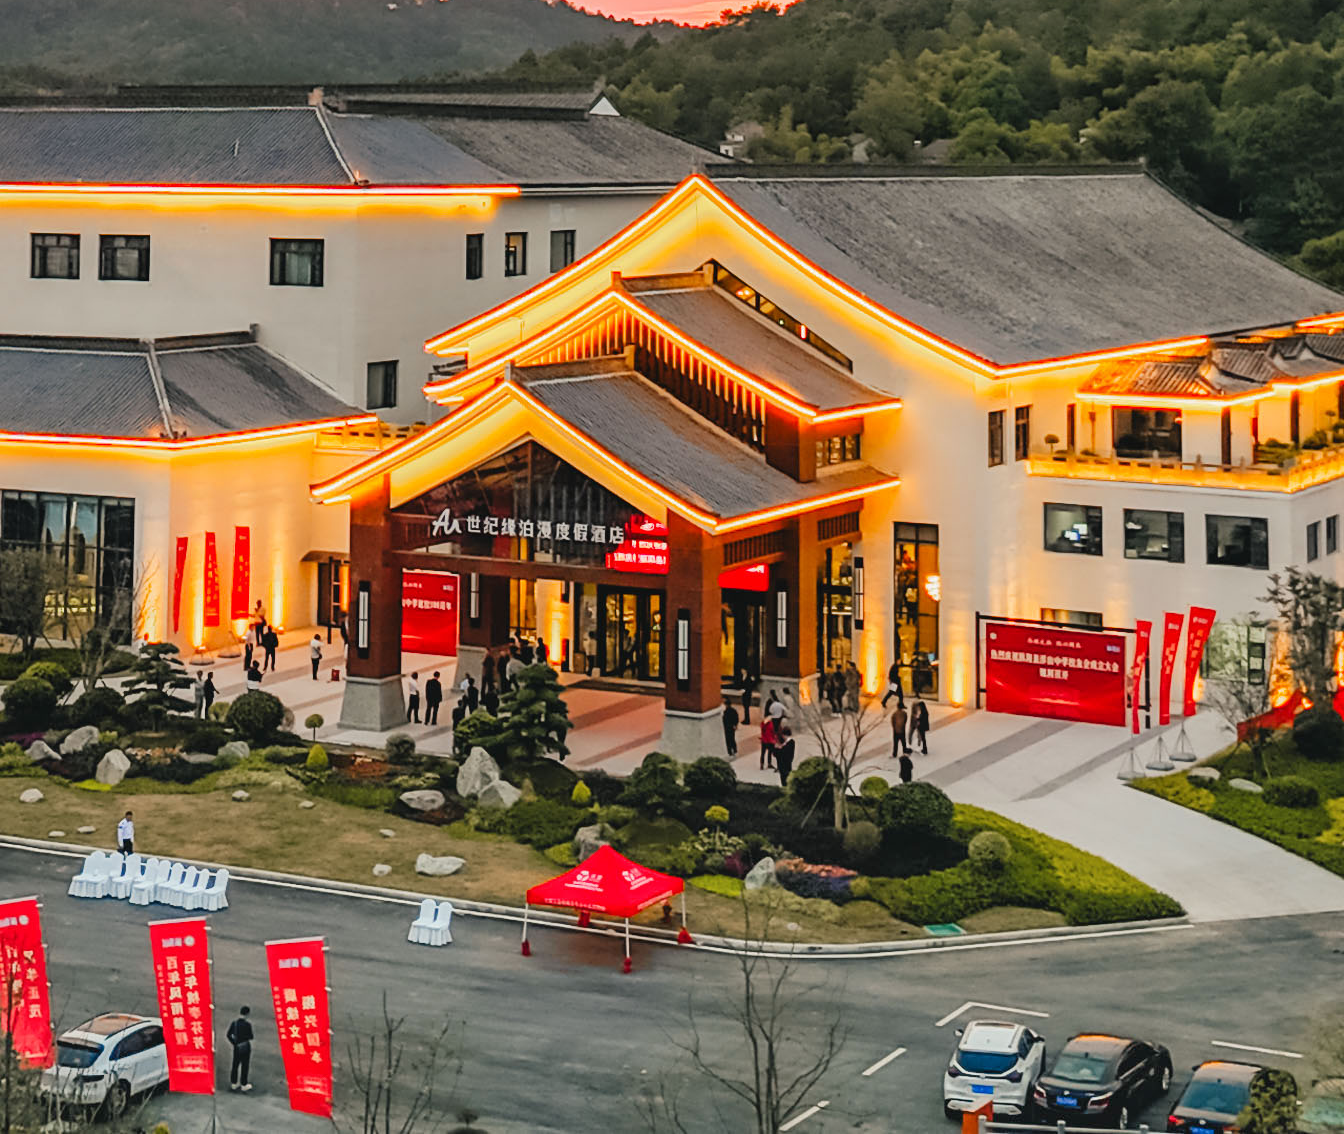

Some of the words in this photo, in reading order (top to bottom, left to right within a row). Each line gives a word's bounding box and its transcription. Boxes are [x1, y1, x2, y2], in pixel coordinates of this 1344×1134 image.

[466, 515, 624, 545] 世纪缘泊漫度假酒店
